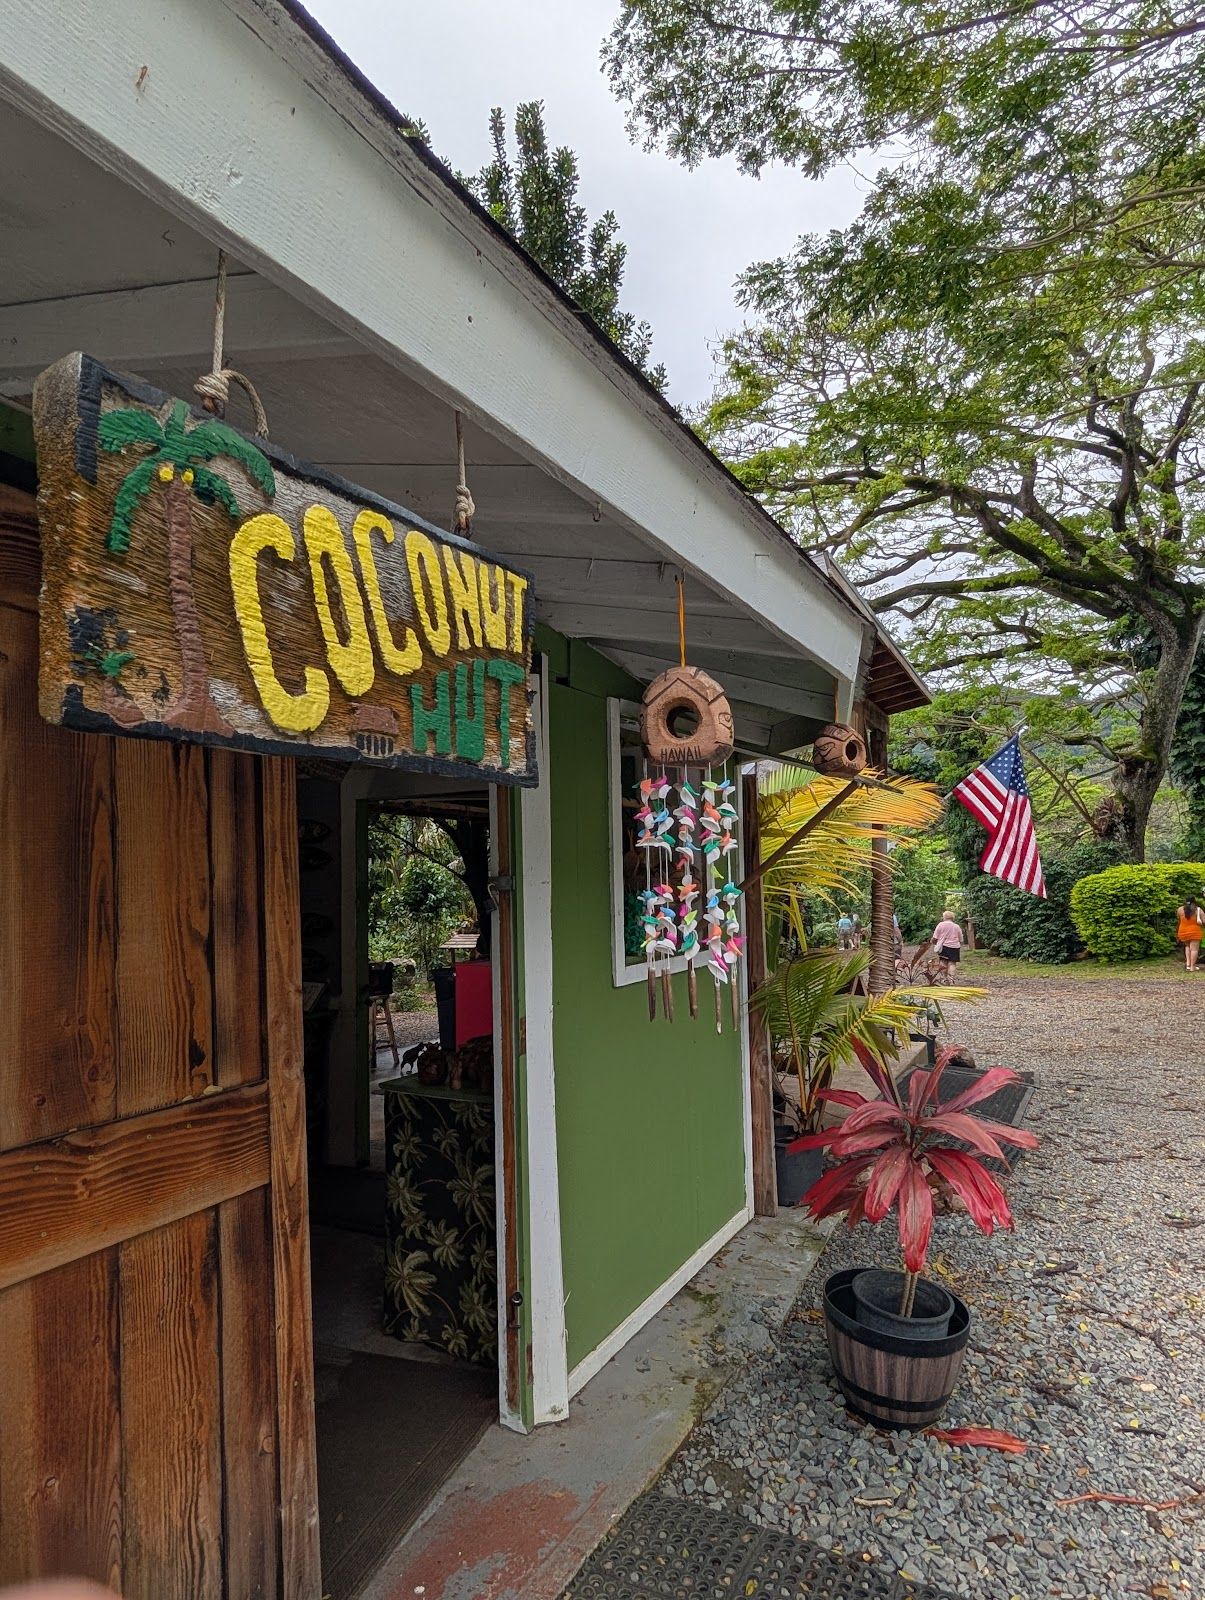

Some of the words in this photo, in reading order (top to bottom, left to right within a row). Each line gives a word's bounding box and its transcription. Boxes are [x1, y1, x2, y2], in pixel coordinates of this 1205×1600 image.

[229, 504, 528, 733] COCONUT
[410, 658, 525, 768] HUT
[660, 745, 701, 763] HAWAII
